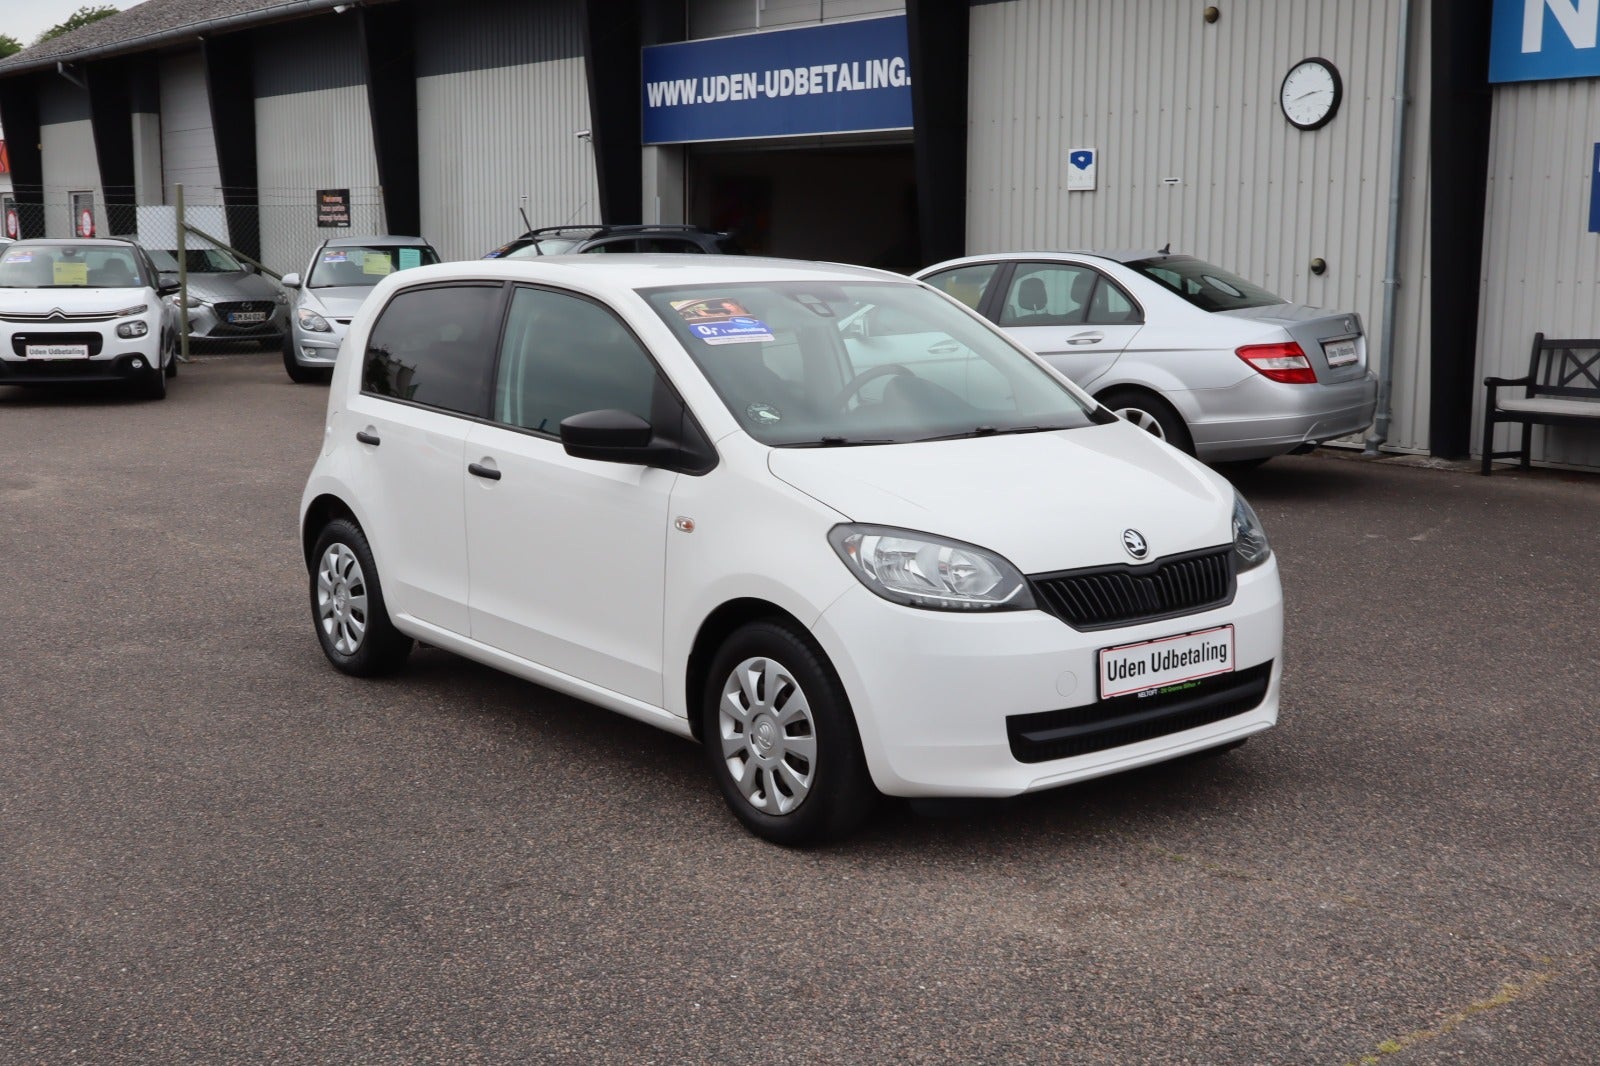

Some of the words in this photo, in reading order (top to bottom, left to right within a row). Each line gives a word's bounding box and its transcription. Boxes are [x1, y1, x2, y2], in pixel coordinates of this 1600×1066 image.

[647, 56, 911, 108] WWW.UDEN-UDBETALING.
[1107, 658, 1146, 682] Uden
[1151, 641, 1227, 673] Udbetaling
